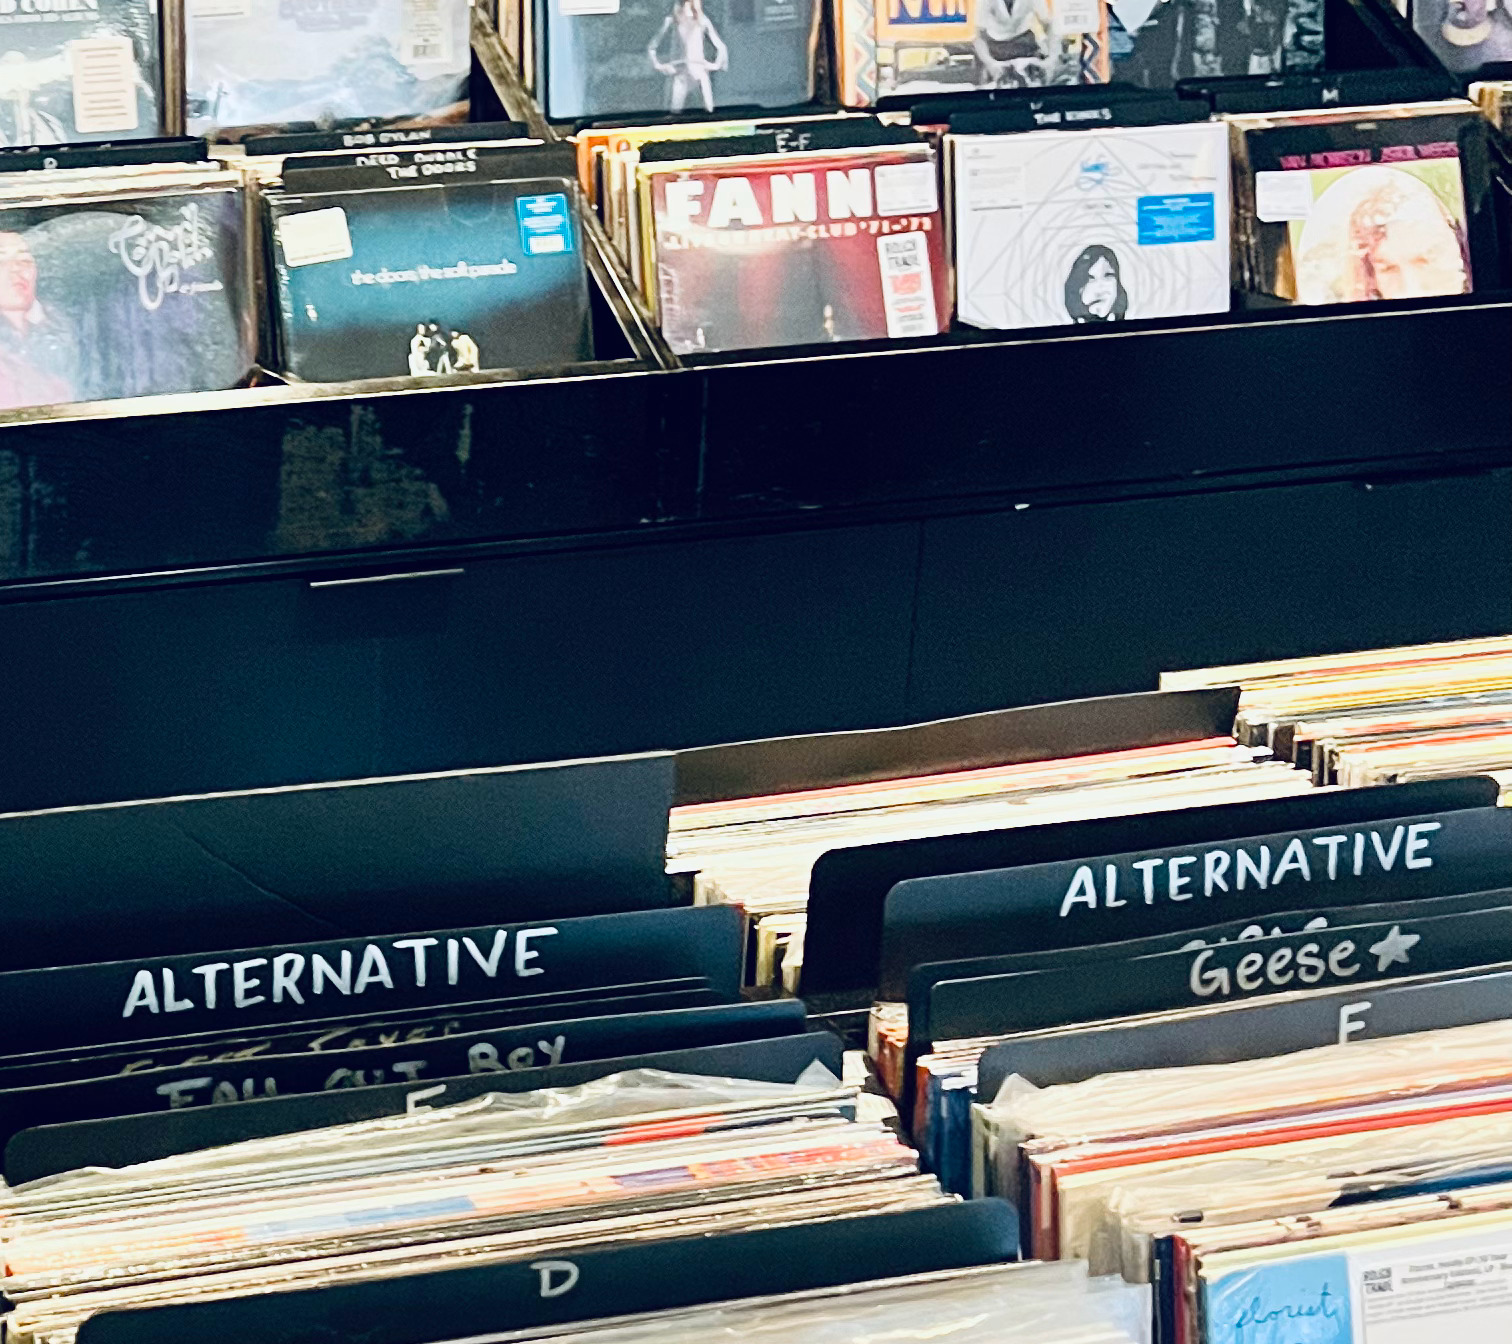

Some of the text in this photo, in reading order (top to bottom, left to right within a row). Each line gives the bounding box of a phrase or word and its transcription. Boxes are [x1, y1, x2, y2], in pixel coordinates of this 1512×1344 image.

[343, 134, 376, 147] BOB
[775, 131, 812, 153] E-F
[421, 160, 477, 176] DOORS
[664, 168, 873, 229] FANN
[1059, 820, 1442, 919] ALTERNATIVE
[121, 926, 559, 1020] ALTERNATIVE
[1190, 936, 1361, 998] Geese
[1338, 1001, 1373, 1044] F
[529, 1260, 580, 1298] D
